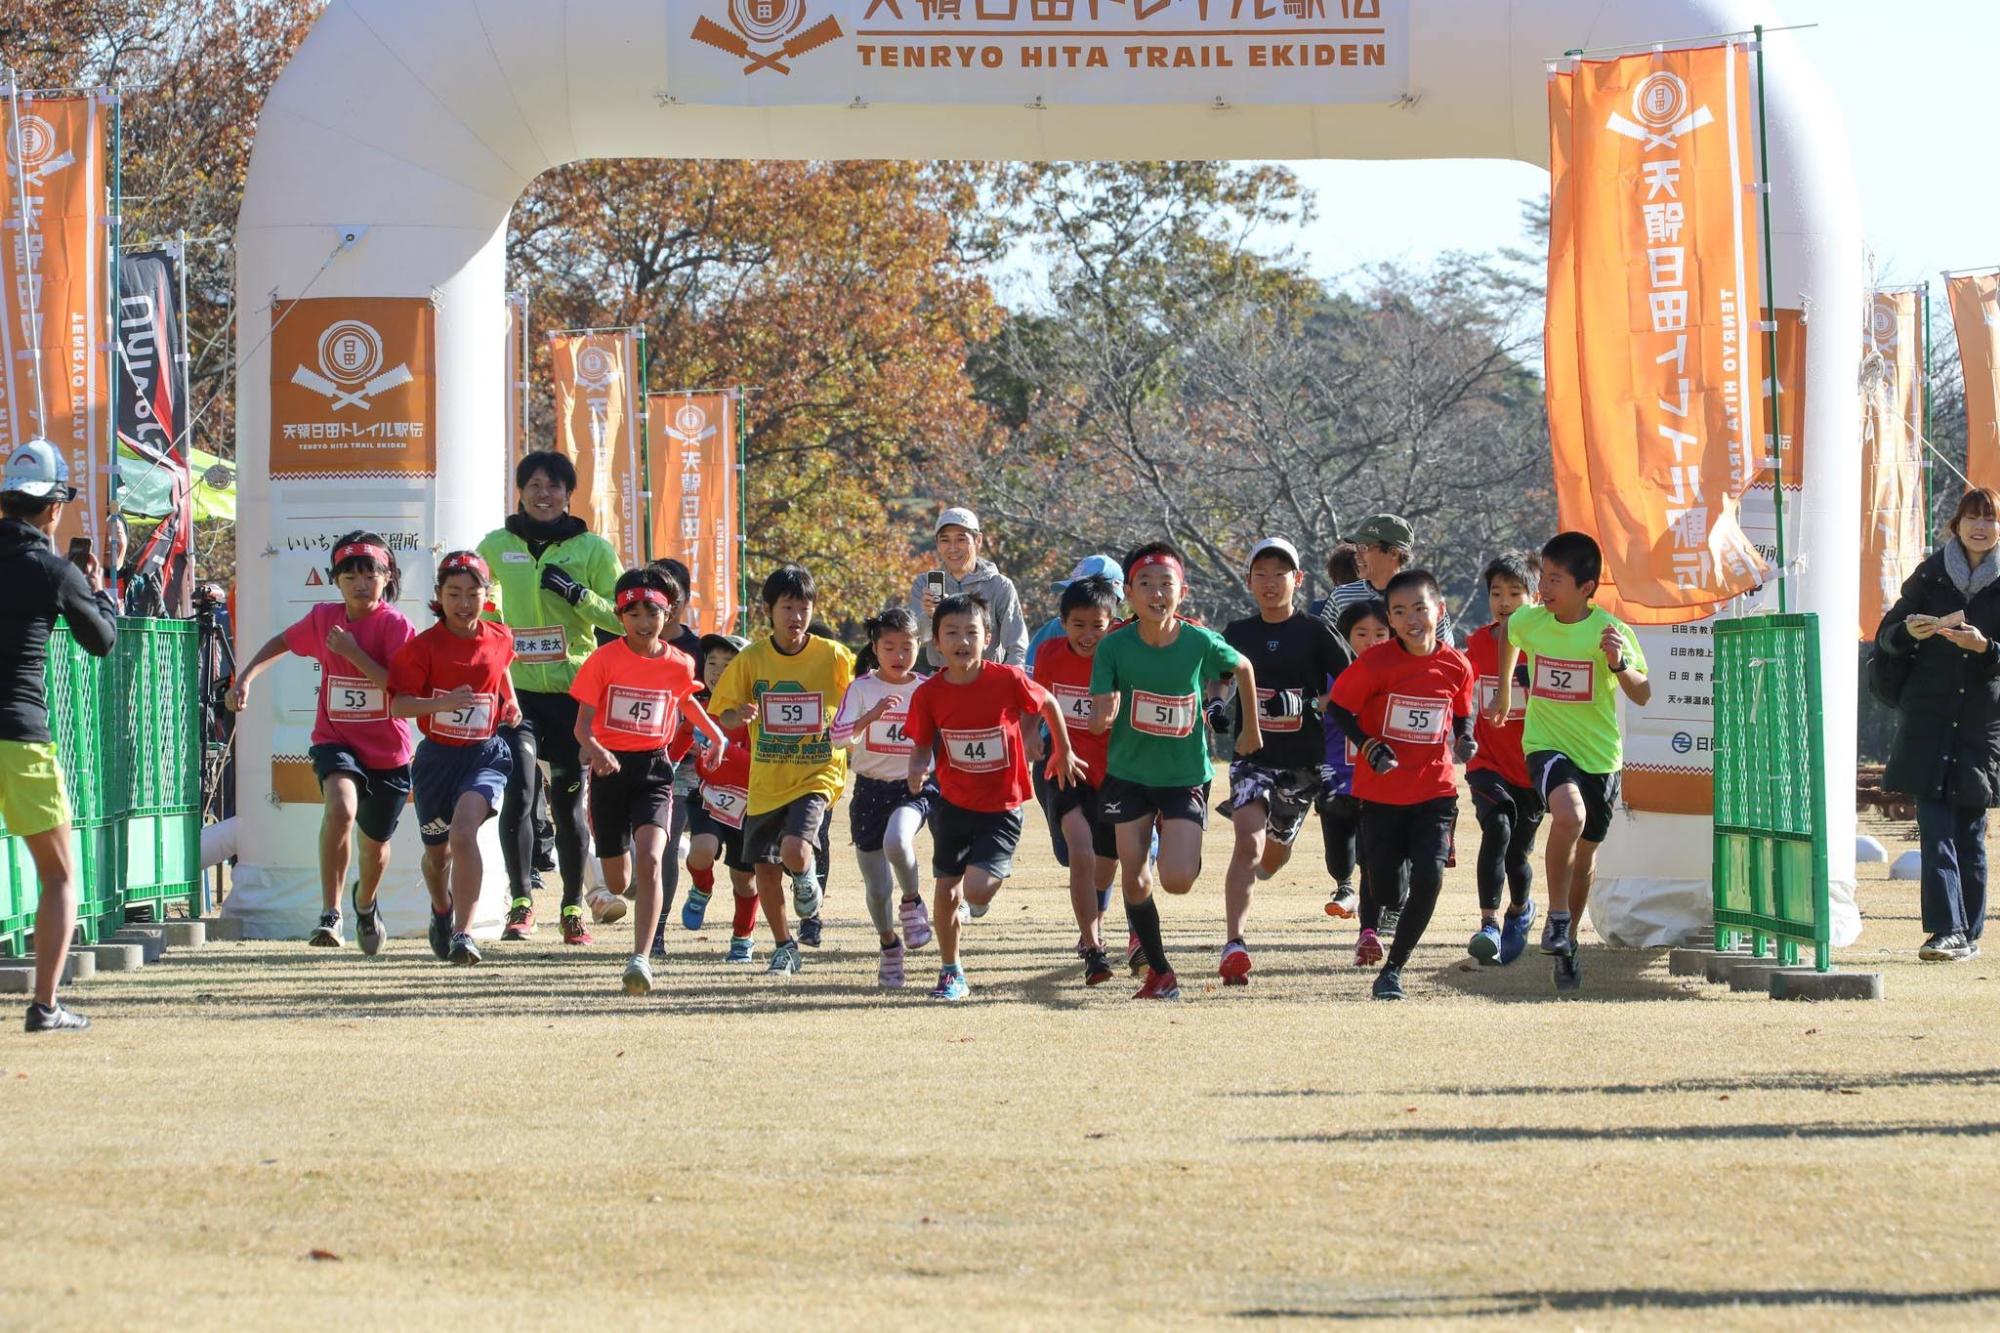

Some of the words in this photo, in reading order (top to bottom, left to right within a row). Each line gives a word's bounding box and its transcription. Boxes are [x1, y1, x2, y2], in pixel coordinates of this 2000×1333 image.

[857, 45, 1003, 68] TENRYO
[1021, 46, 1109, 68] HITA
[1124, 45, 1233, 68] TRAIL
[1249, 43, 1386, 67] EKIDEN
[343, 340, 356, 365] 日田
[283, 422, 425, 439] 天領日田トレイル駅伝
[515, 640, 537, 652] 荒木
[541, 638, 562, 652] 宏太
[1550, 669, 1572, 689] 52
[344, 690, 367, 708] 53
[1072, 698, 1093, 716] 43
[452, 706, 476, 724] 57
[628, 701, 653, 721] 45
[781, 704, 803, 722] 59
[1155, 705, 1174, 724] 51
[1407, 709, 1430, 729] 55
[964, 742, 986, 759] 44
[715, 793, 736, 811] 32
